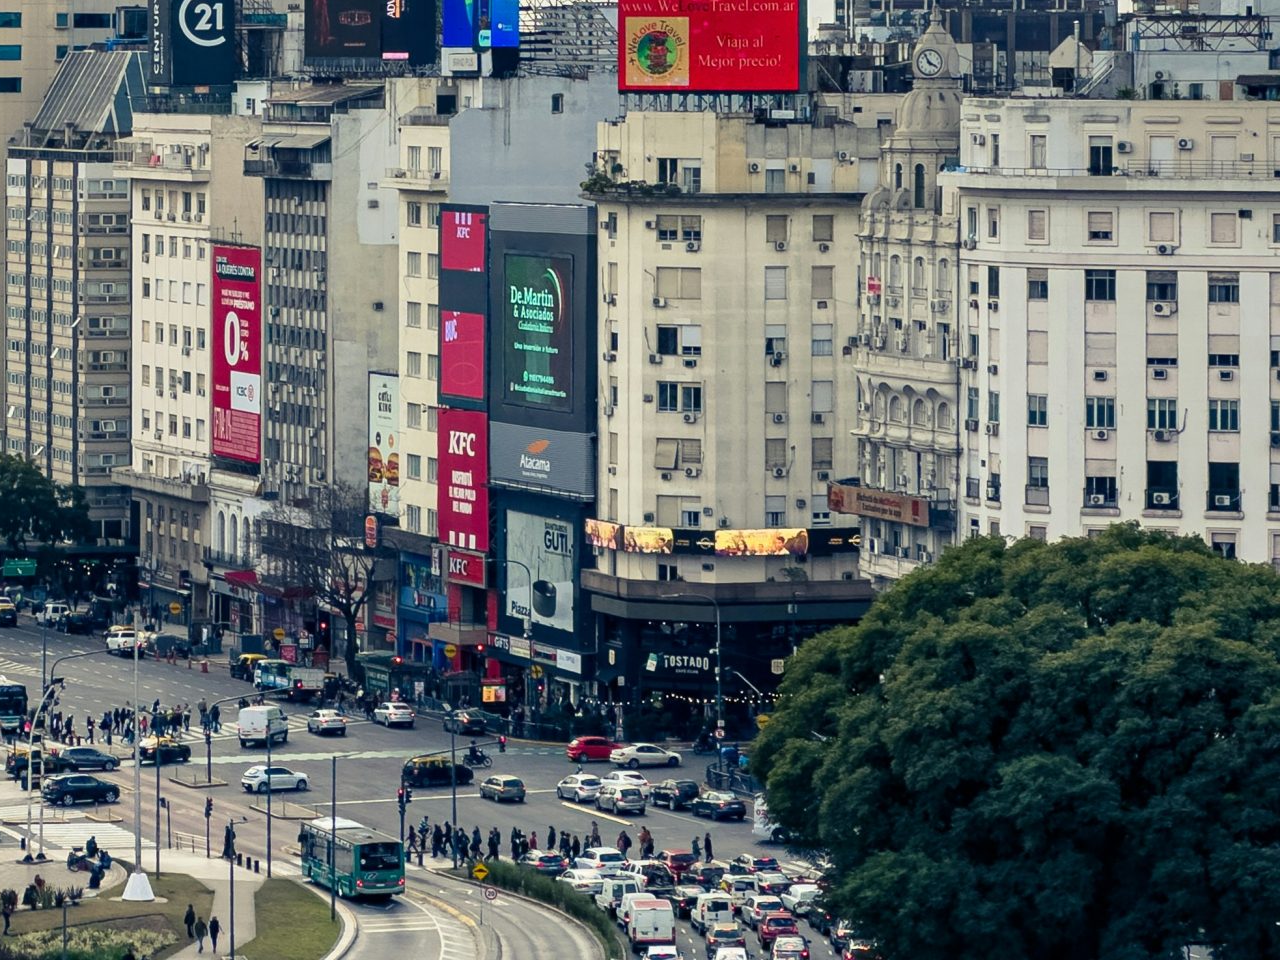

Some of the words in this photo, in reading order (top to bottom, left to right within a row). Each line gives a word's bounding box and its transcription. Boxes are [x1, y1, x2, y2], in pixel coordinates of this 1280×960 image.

[621, 0, 795, 13] www.WeLoveTravel.com.ar
[716, 35, 749, 49] Viaja
[753, 34, 764, 48] al
[698, 54, 735, 68] Mejor
[739, 54, 782, 70] precio!
[456, 226, 470, 238] KFC
[510, 285, 554, 308] De.Martin
[513, 304, 519, 318] &
[521, 305, 554, 322] Asociados
[378, 402, 392, 414] KING
[448, 430, 476, 457] KFC
[519, 454, 551, 472] Atacama
[449, 557, 468, 576] KFC
[494, 636, 509, 650] GIFTS
[663, 654, 709, 670] TOSTADO
